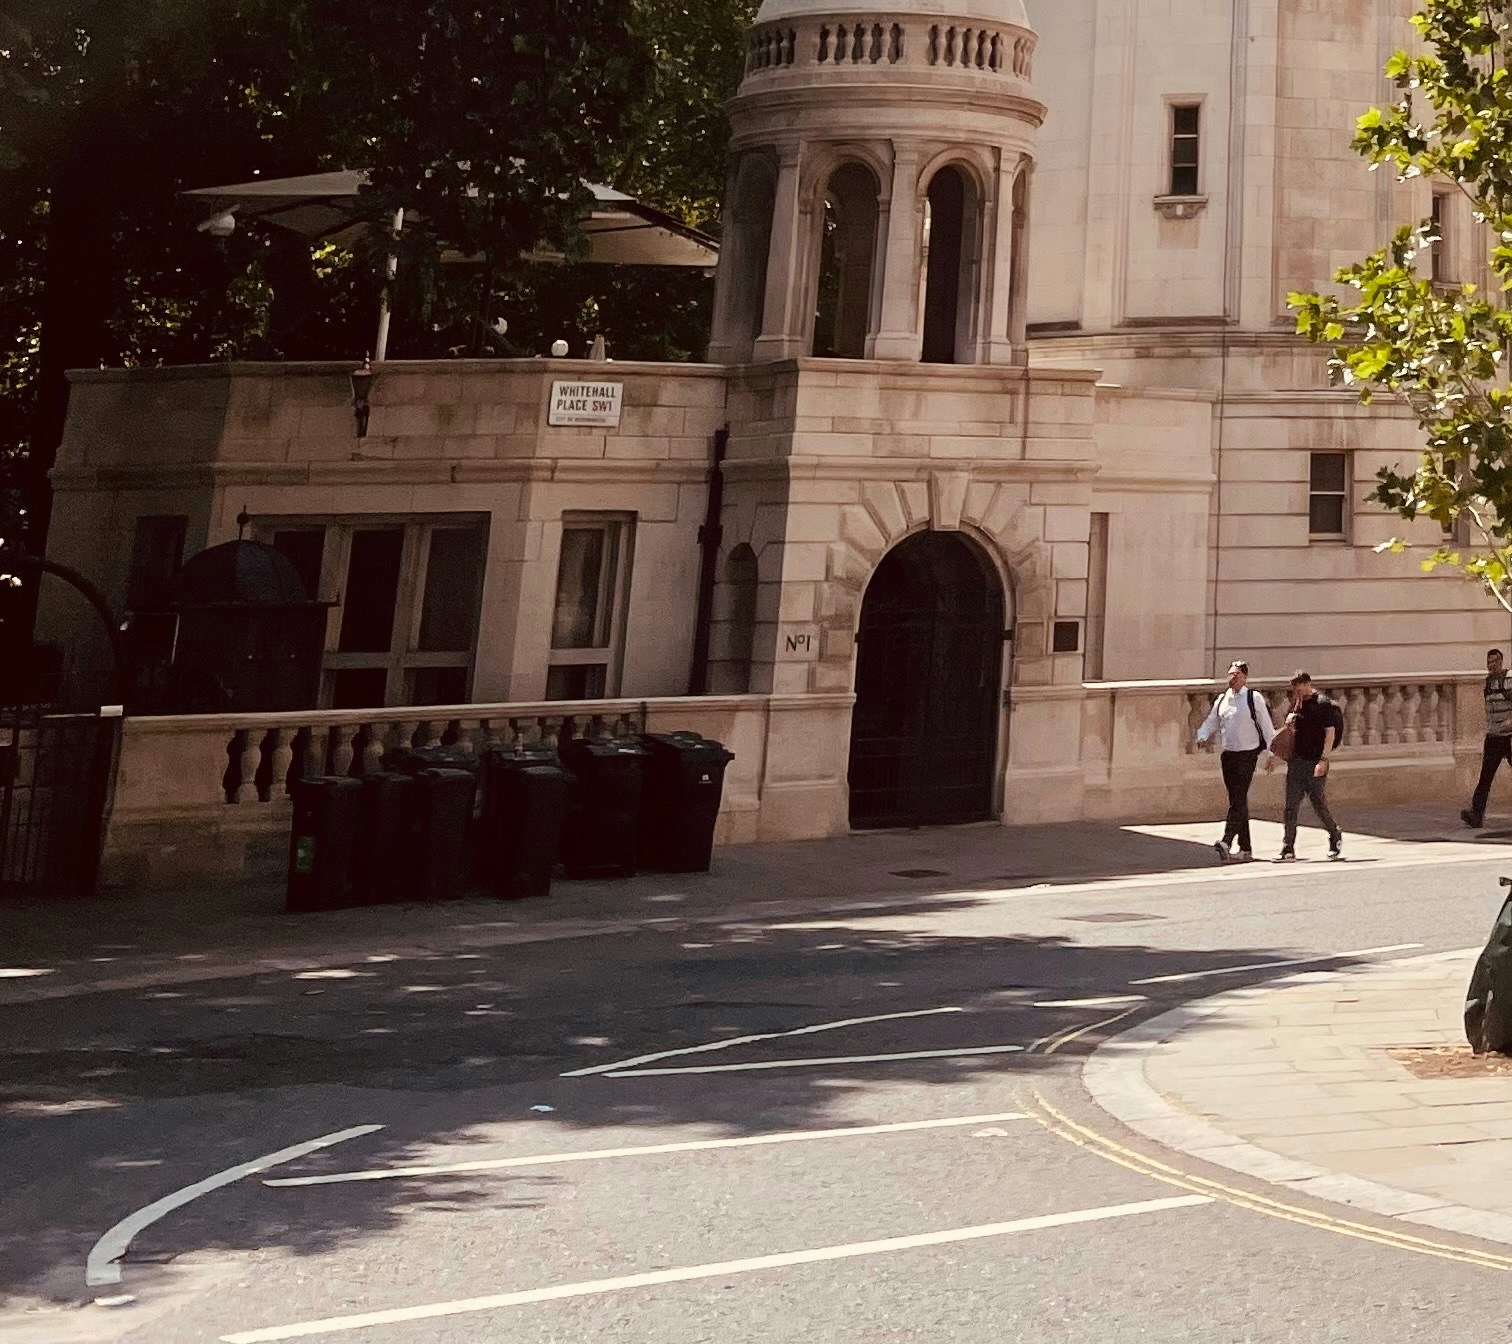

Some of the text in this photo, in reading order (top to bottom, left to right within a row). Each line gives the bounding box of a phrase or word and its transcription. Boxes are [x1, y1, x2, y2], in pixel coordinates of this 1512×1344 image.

[559, 385, 616, 399] WHITEHALL
[556, 399, 613, 412] PLACE SW1
